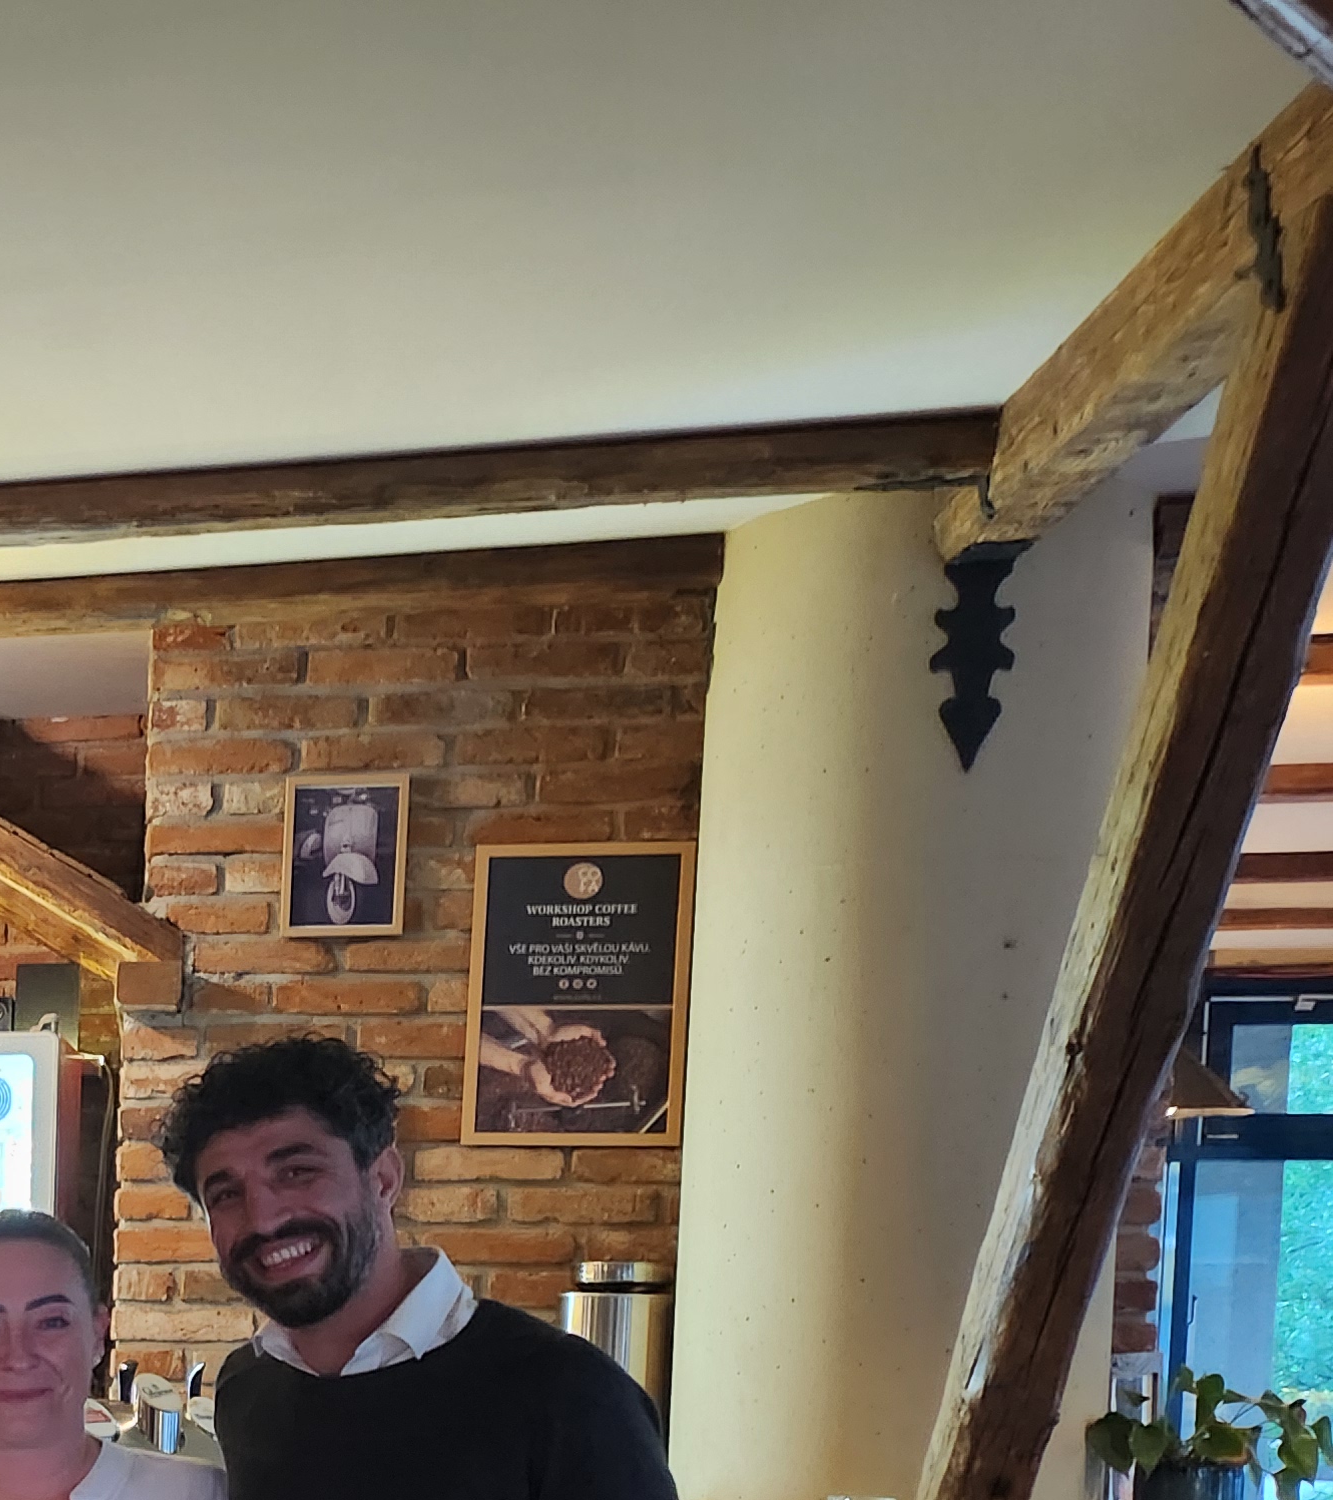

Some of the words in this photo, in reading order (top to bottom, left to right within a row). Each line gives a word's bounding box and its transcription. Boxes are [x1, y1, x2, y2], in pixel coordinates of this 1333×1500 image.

[526, 904, 593, 915] WORKSHOP
[595, 903, 638, 915] COFFEE
[552, 916, 610, 927] ROASTERS
[509, 943, 526, 955] VŠE
[529, 943, 550, 954] PRO
[551, 942, 572, 954] VAŠI
[533, 965, 551, 976] BEZ
